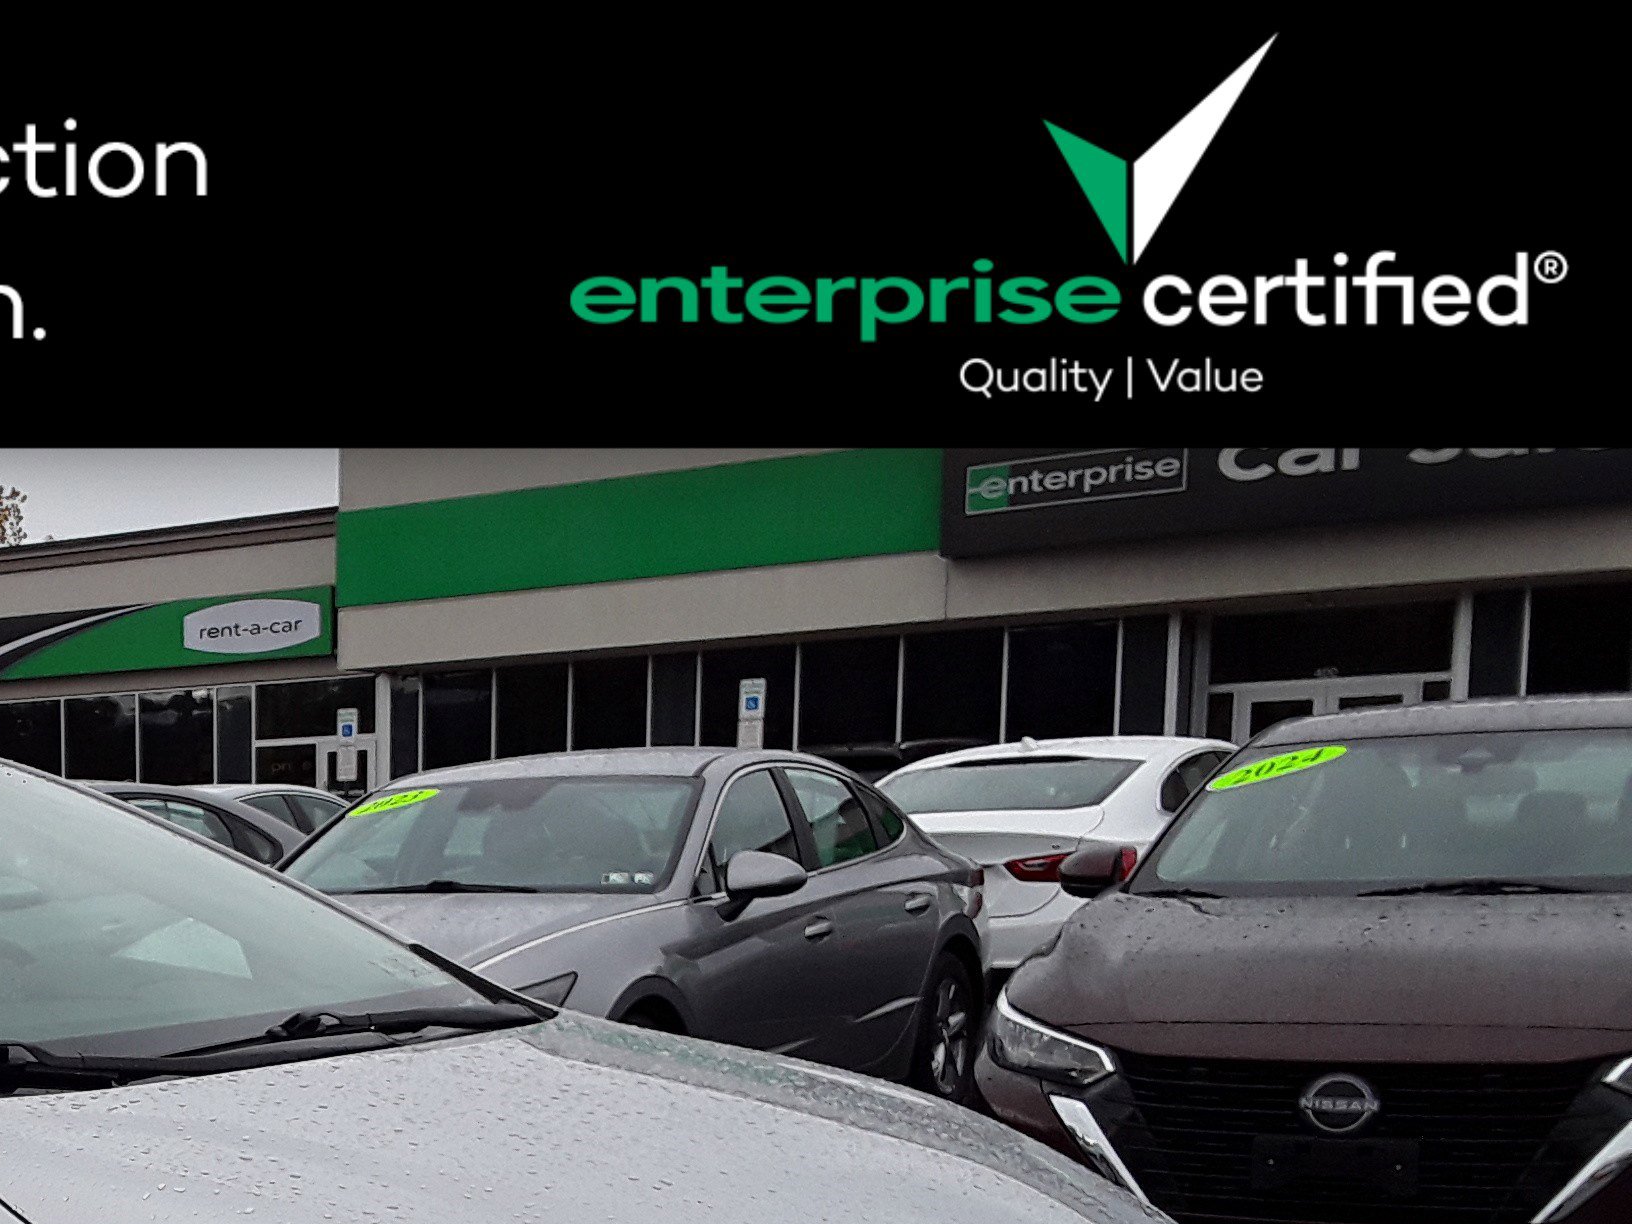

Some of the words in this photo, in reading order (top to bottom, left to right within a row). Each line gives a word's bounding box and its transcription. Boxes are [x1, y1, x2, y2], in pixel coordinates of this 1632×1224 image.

[971, 453, 1181, 500] enterprise
[199, 618, 303, 640] rent-a-car
[1230, 748, 1325, 785] 2024
[1300, 1097, 1379, 1112] NISSAN
